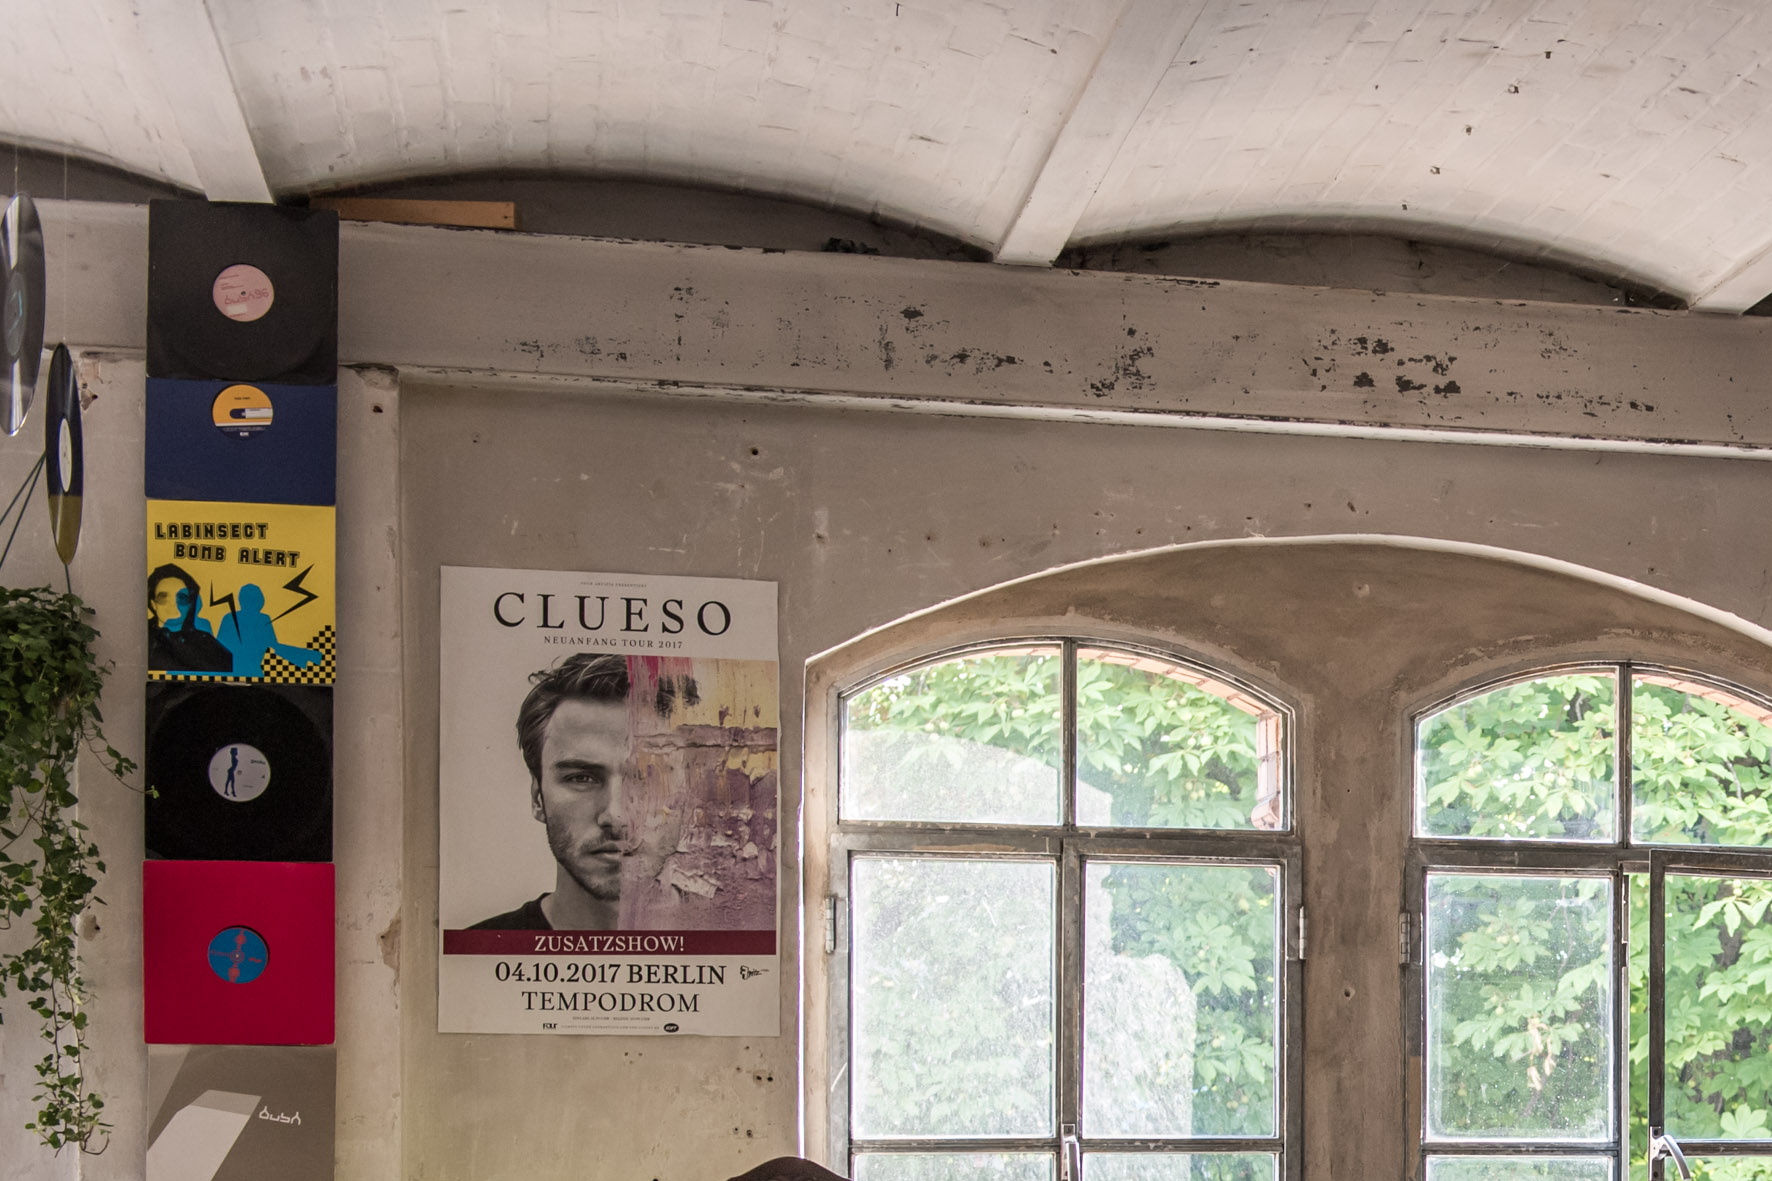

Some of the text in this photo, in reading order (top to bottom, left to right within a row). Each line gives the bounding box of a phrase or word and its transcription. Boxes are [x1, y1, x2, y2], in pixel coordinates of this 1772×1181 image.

[154, 522, 269, 540] LABINSECT
[174, 541, 300, 568] BOMB ALERT
[493, 592, 731, 636] CLUESO
[543, 636, 683, 649] NEUANFANG TOUR 2017
[534, 935, 685, 952] ZUSATZSHOW!
[494, 961, 727, 985] 04.10.2017 BERLIN
[521, 991, 701, 1013] TEMPODROM
